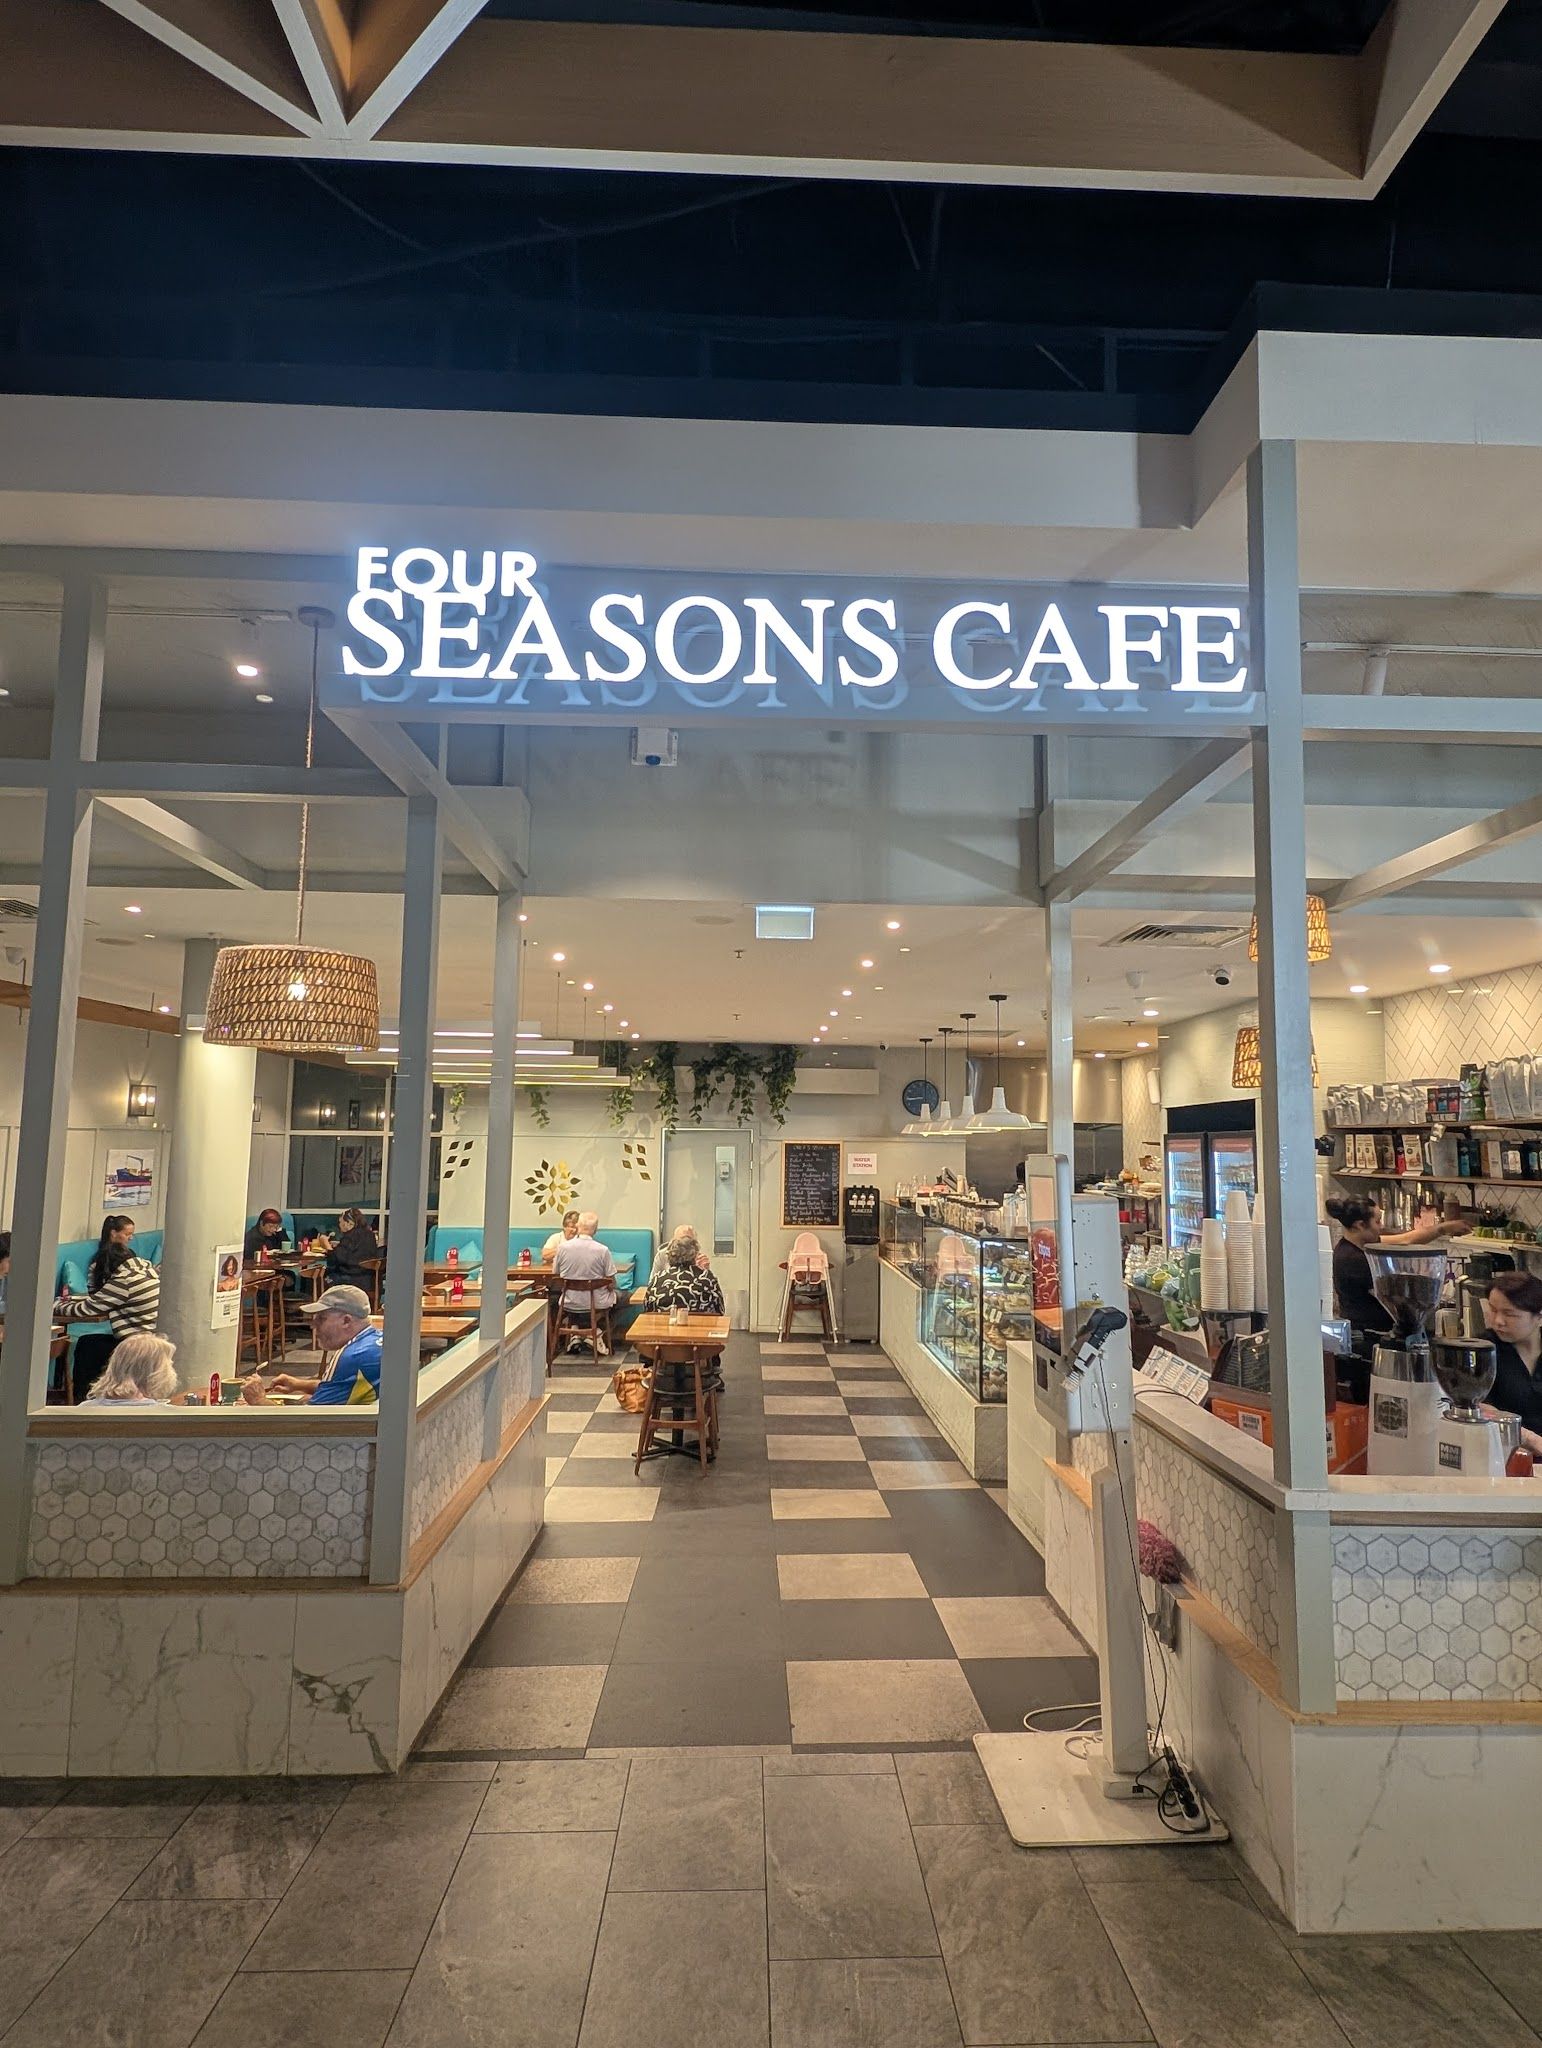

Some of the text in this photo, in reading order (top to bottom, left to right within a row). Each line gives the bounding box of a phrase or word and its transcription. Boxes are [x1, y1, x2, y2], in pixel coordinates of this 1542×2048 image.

[356, 546, 537, 598] FOUR
[341, 586, 1248, 693] SEASONS CAFE
